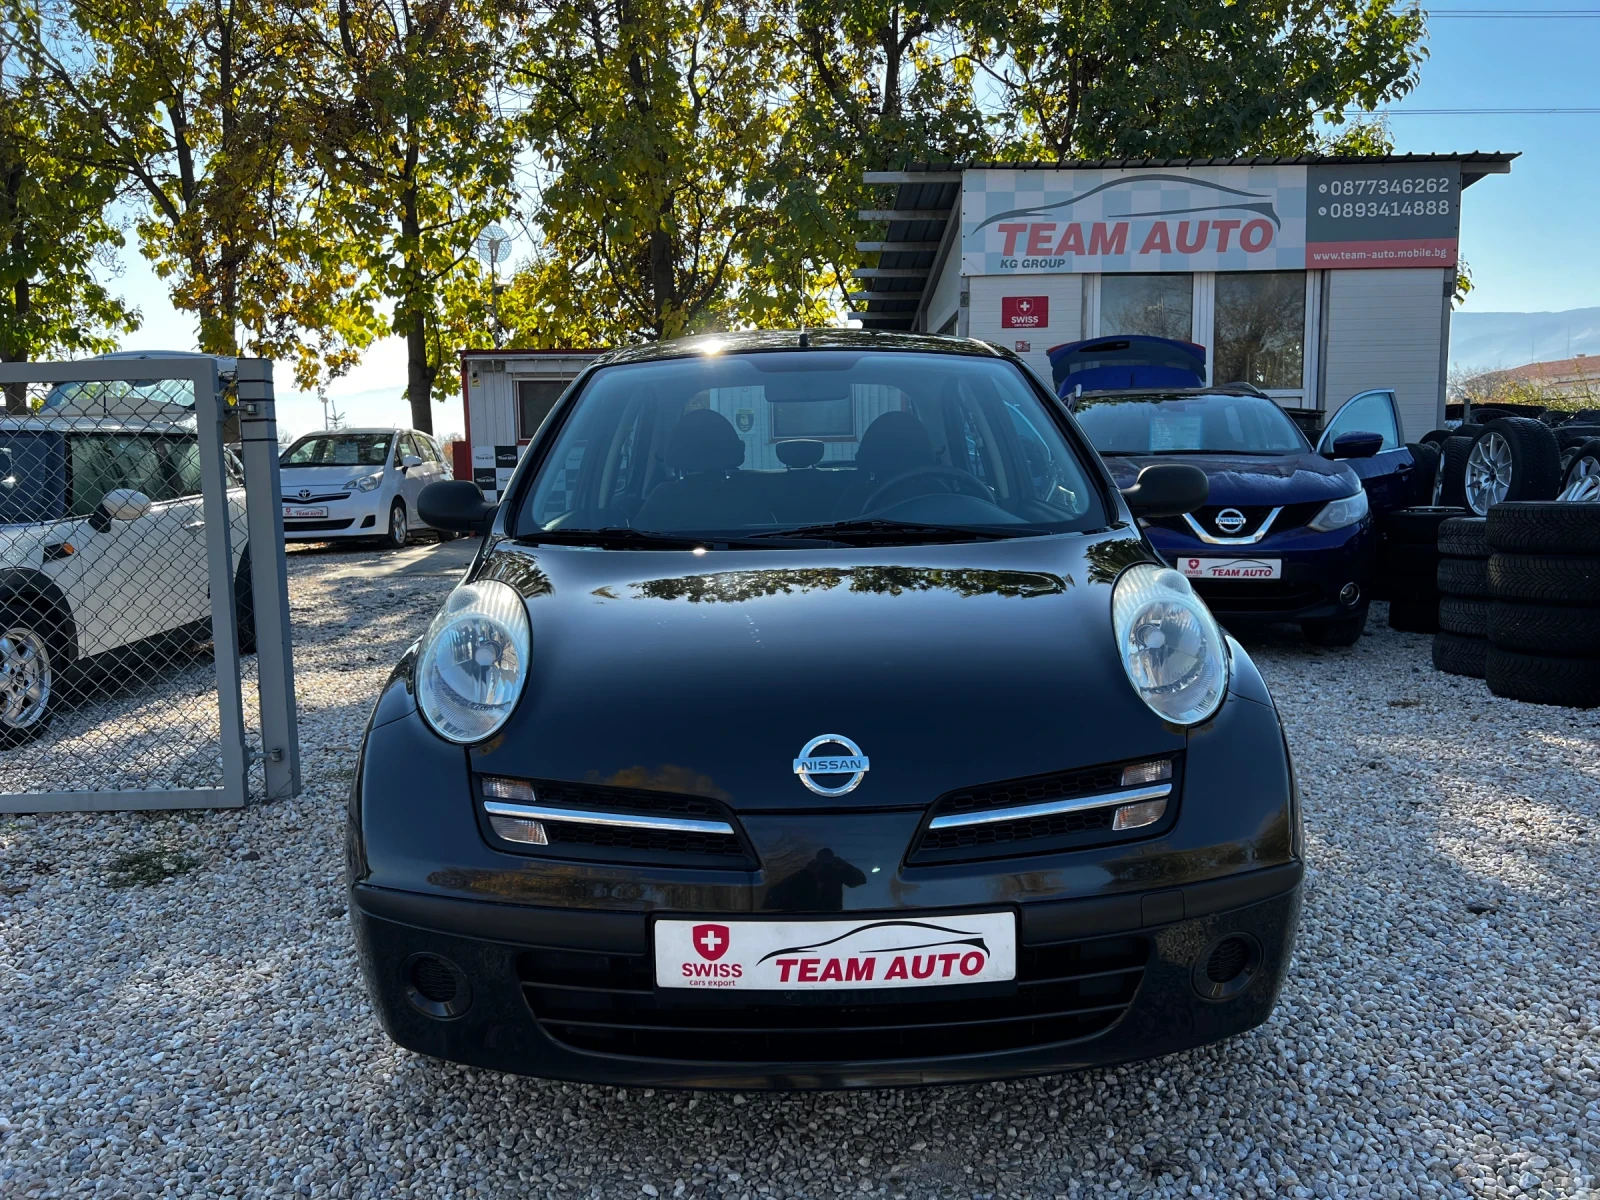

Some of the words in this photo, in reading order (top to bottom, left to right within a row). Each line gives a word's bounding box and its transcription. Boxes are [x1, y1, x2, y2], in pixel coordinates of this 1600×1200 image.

[1330, 177, 1449, 196] 0877346262
[1330, 200, 1449, 218] 0893414888
[998, 222, 1130, 256] TEAM
[1138, 218, 1274, 255] AUTO
[1313, 248, 1447, 260] www.team-auto.mobile.bg
[1000, 259, 1019, 269] KG
[1021, 258, 1066, 269] GROUP
[1011, 315, 1039, 324] SWISS
[1211, 569, 1240, 577] TEAM
[1242, 569, 1272, 577] AUTO
[801, 760, 861, 770] NISSAN
[681, 962, 743, 978] SWISS
[776, 957, 876, 983] TEAM
[884, 951, 985, 981] AUTO
[689, 979, 706, 987] cars
[707, 979, 736, 988] export
